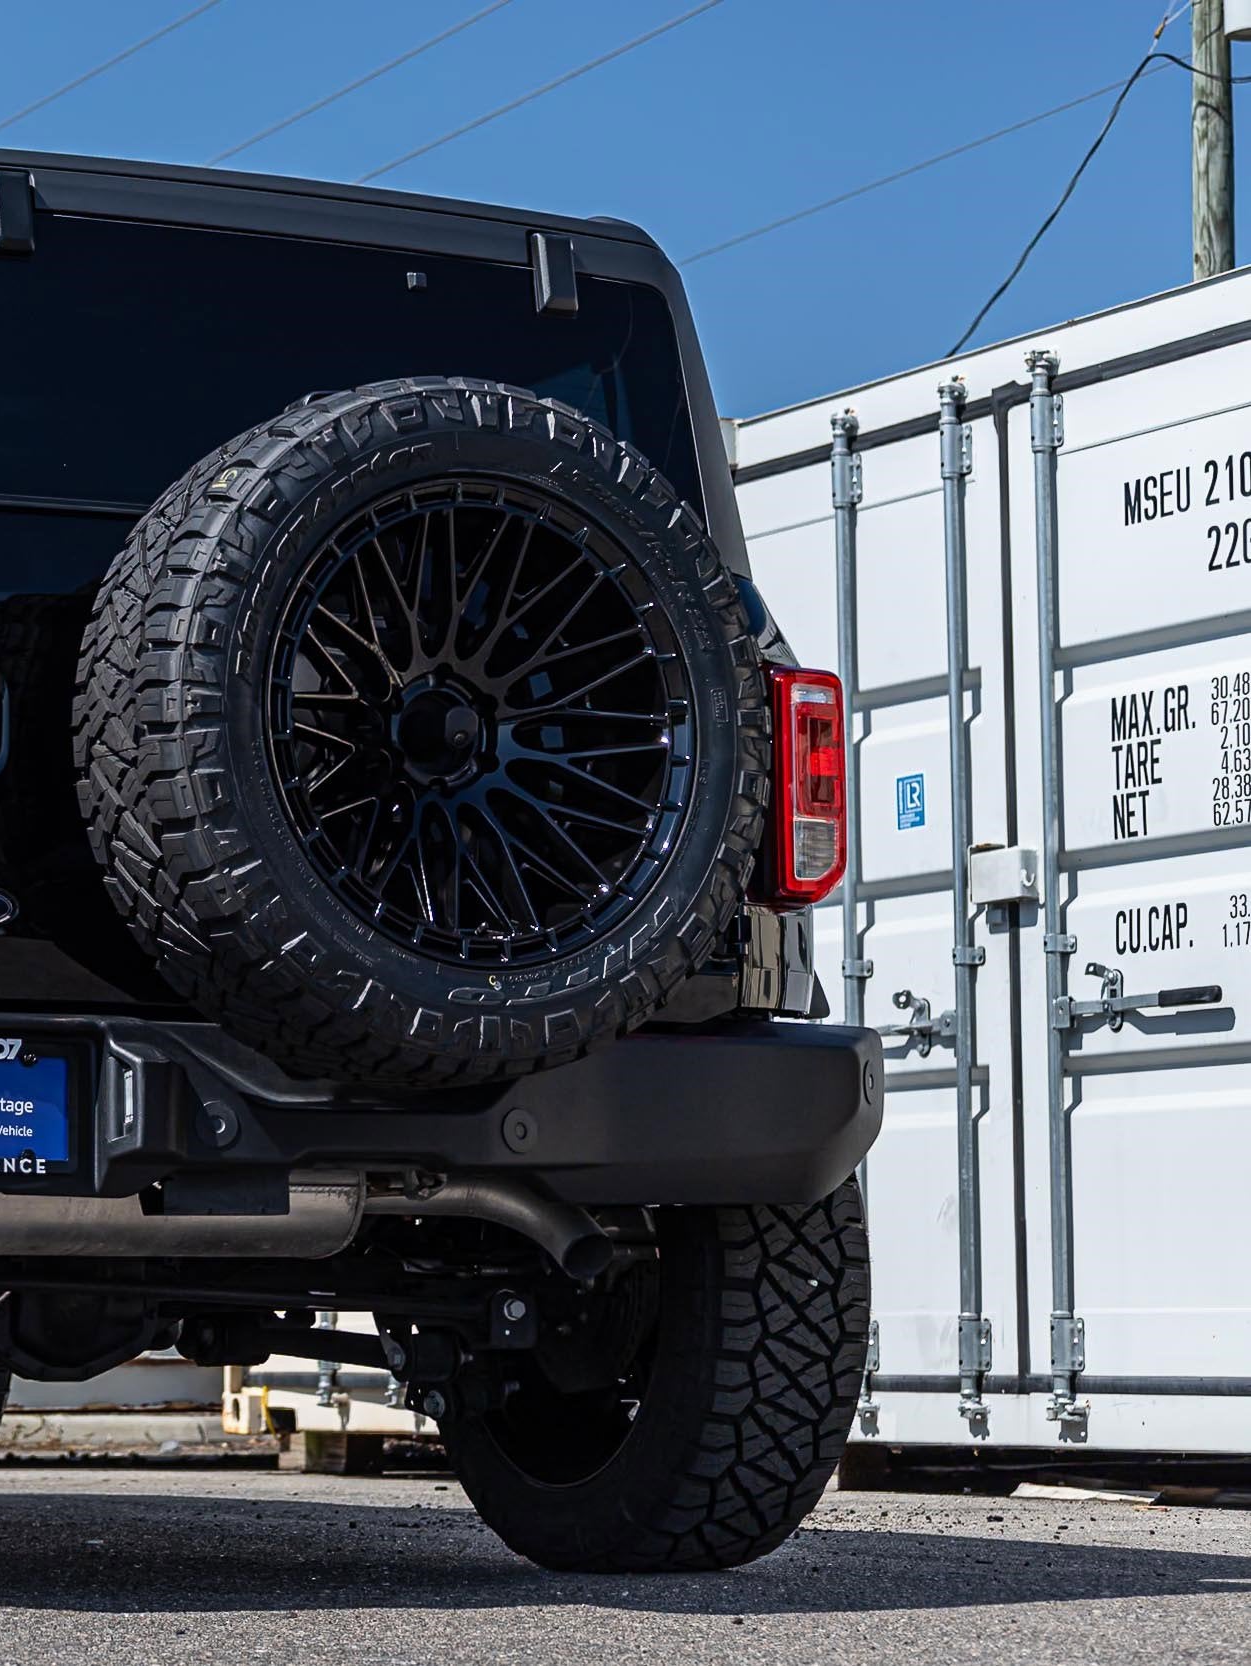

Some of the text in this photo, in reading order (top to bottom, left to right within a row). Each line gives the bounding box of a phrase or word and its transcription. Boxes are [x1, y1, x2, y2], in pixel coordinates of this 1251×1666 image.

[1124, 451, 1251, 526] MSEU 210
[1110, 683, 1196, 742] MAX.GR.
[1112, 738, 1162, 790] TARE
[1113, 790, 1149, 841] NET
[1115, 902, 1194, 955] CU.CAP.
